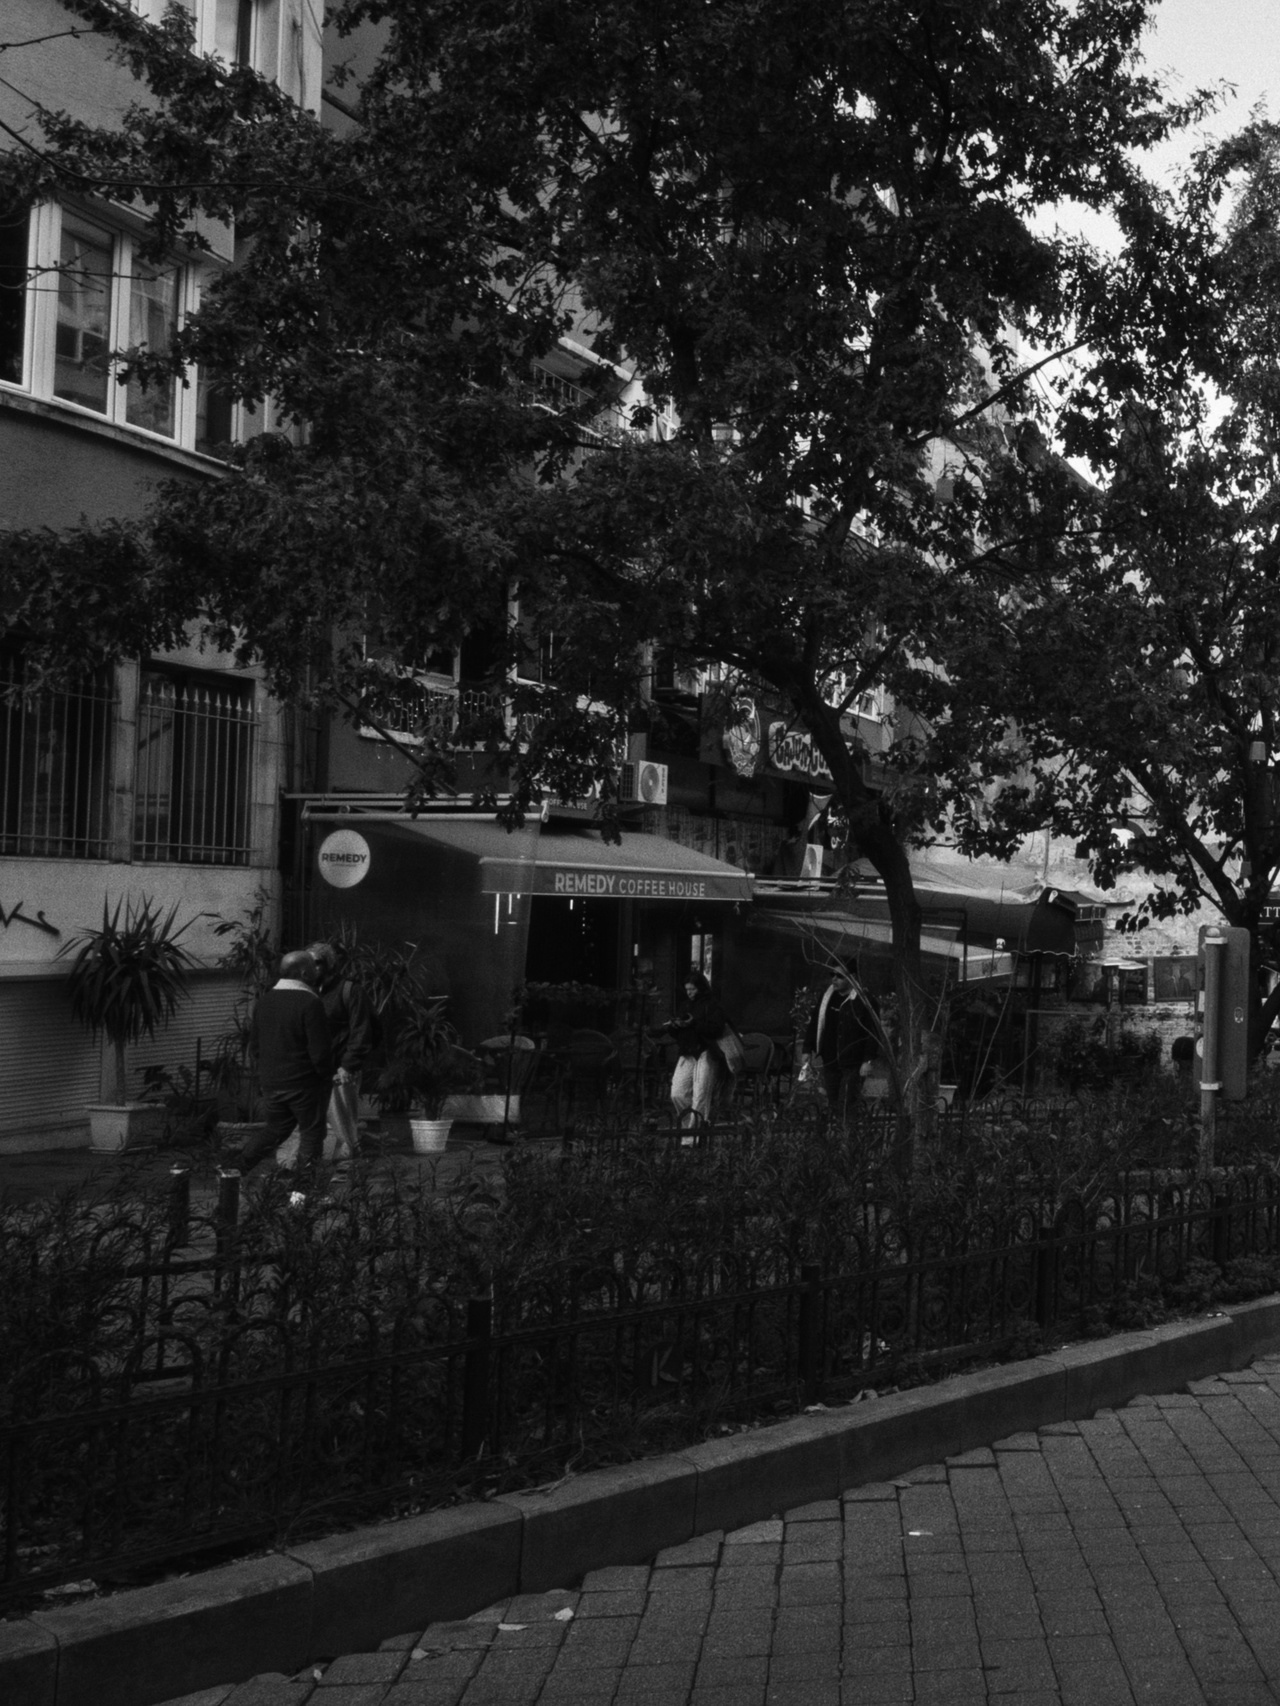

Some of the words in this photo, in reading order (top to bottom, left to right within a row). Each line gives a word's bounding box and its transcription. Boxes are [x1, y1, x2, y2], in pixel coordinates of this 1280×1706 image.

[322, 852, 367, 863] REMEDY
[555, 872, 616, 893] REMEDY
[619, 878, 666, 895] COFFEE
[668, 881, 706, 897] HOUSE
